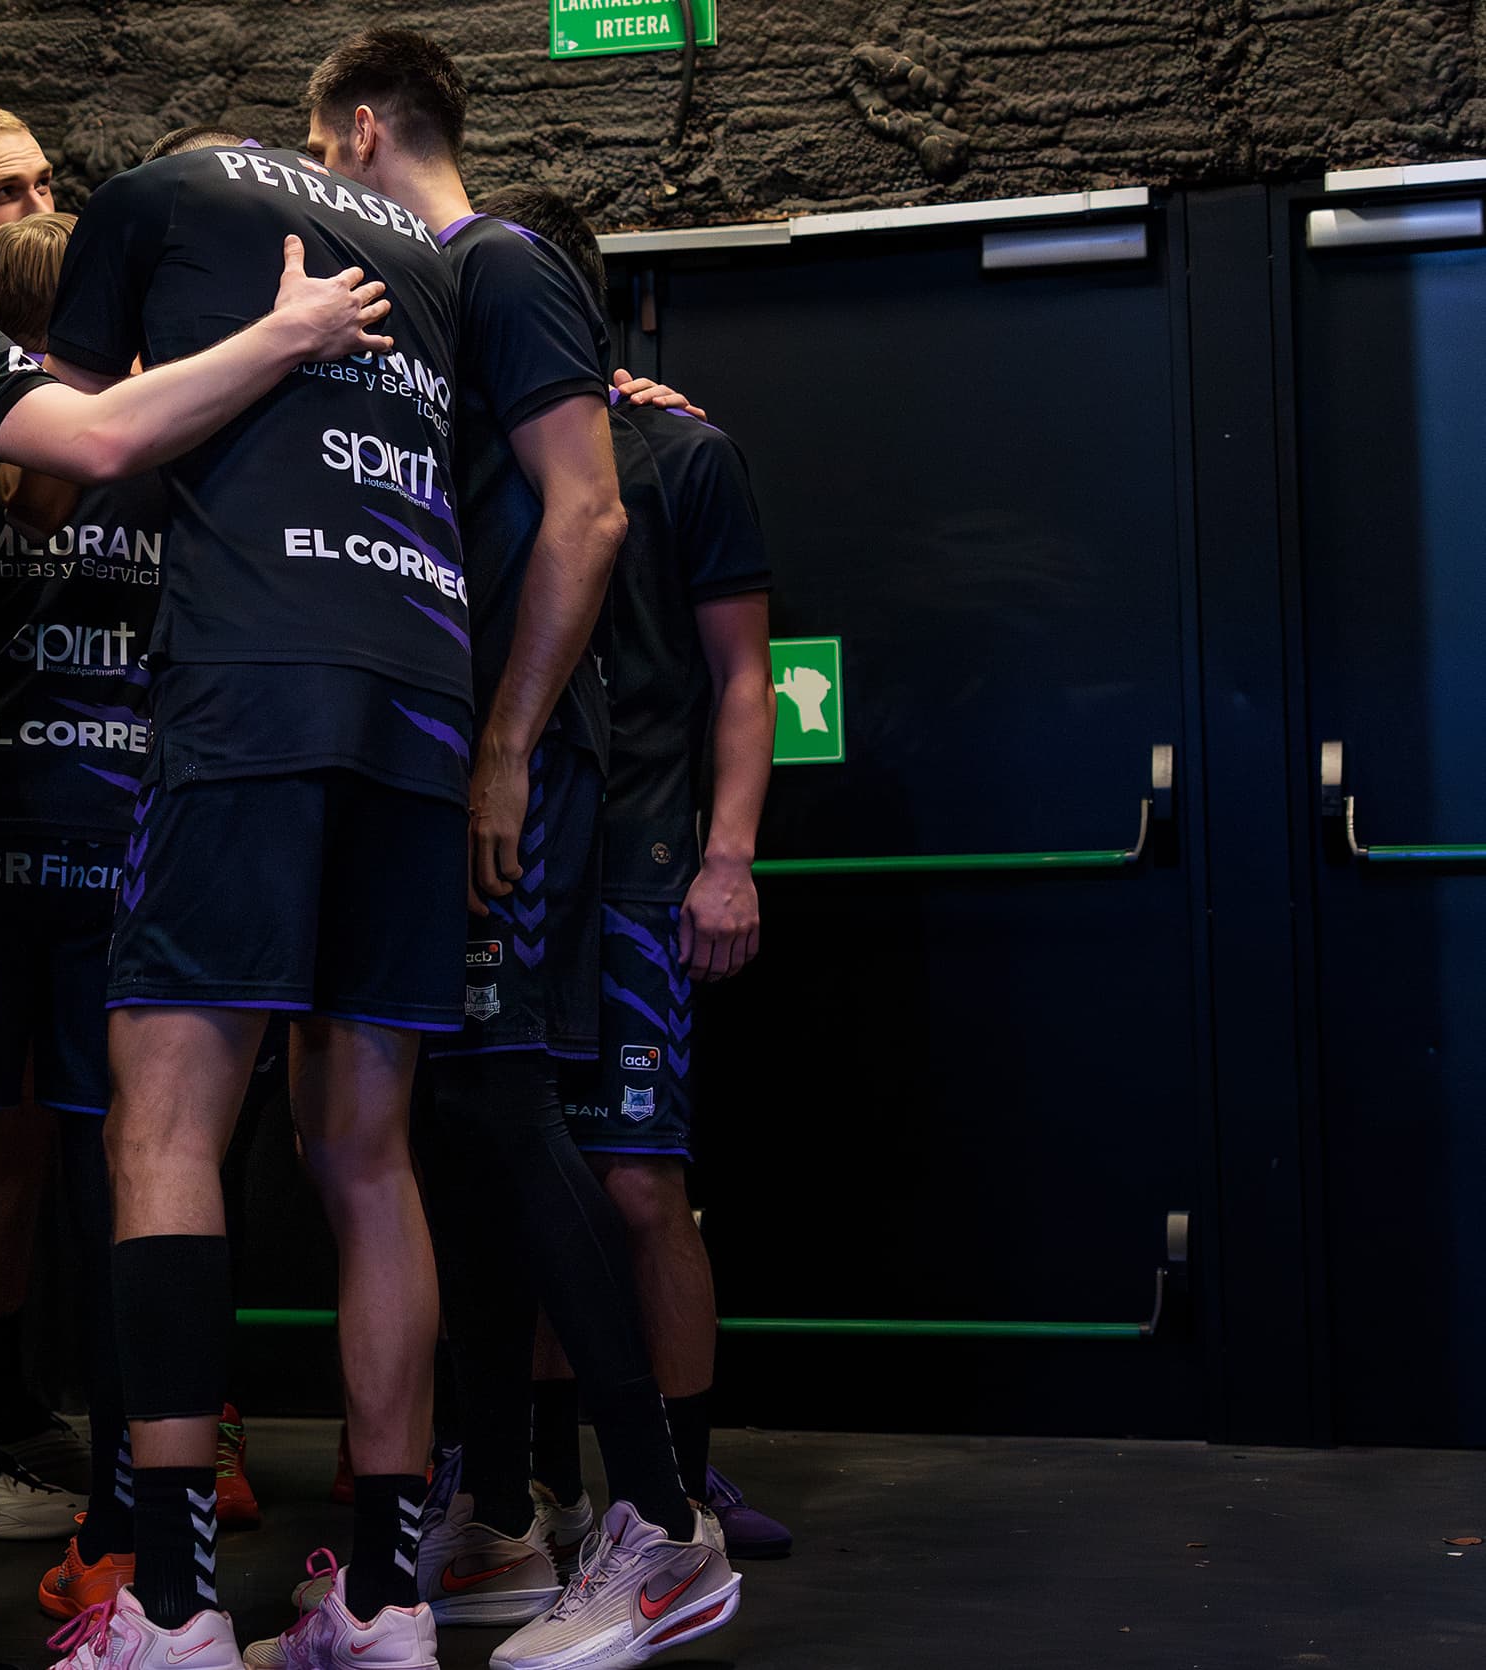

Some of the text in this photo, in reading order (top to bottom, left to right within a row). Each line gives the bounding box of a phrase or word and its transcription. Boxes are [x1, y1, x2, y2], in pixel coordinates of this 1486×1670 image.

[595, 14, 670, 39] IRTEERA
[214, 151, 440, 255] PETRASEK
[364, 373, 377, 392] y
[284, 528, 340, 560] EL
[61, 561, 76, 579] y
[81, 558, 160, 586] Servici
[19, 721, 149, 754] CORRE
[625, 1056, 651, 1067] acb
